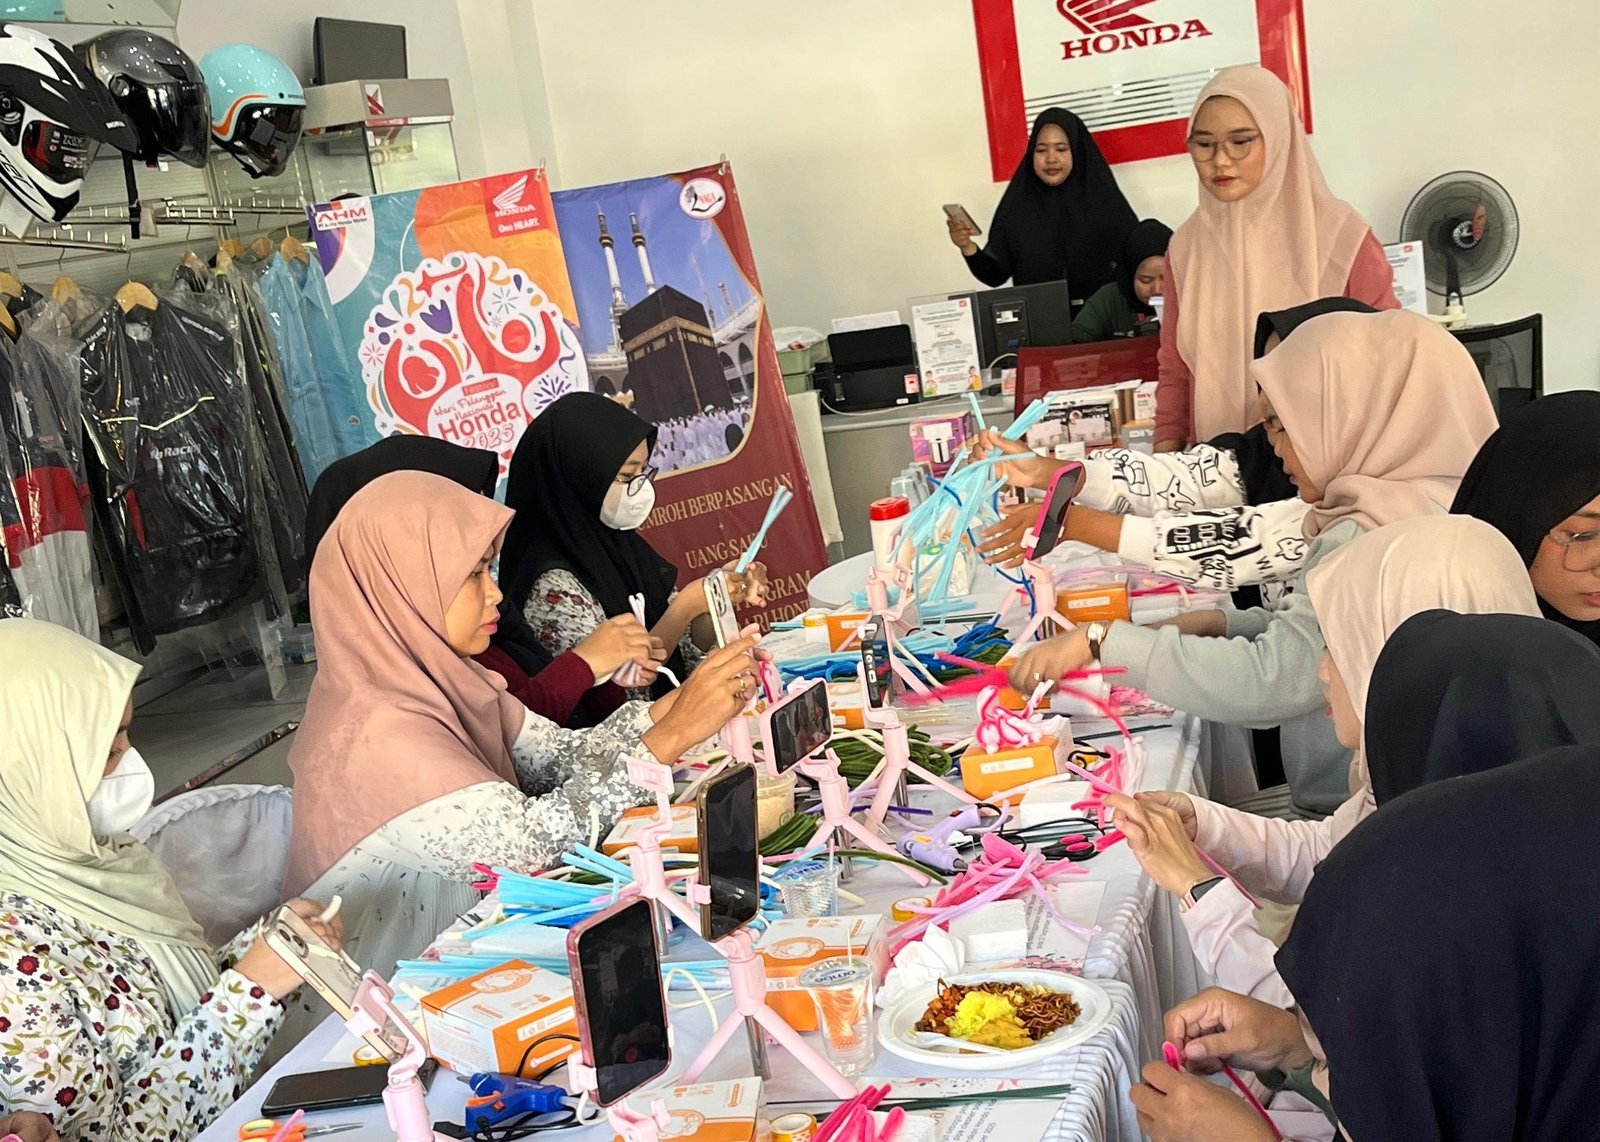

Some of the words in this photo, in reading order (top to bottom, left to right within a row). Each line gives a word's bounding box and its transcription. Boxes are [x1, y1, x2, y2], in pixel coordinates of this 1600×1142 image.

[1060, 18, 1213, 60] HONDA
[318, 207, 367, 223] AHM
[495, 204, 536, 218] HONDA
[497, 223, 513, 233] One
[437, 401, 521, 441] Honda
[638, 499, 688, 531] MROH
[685, 541, 728, 569] UANG
